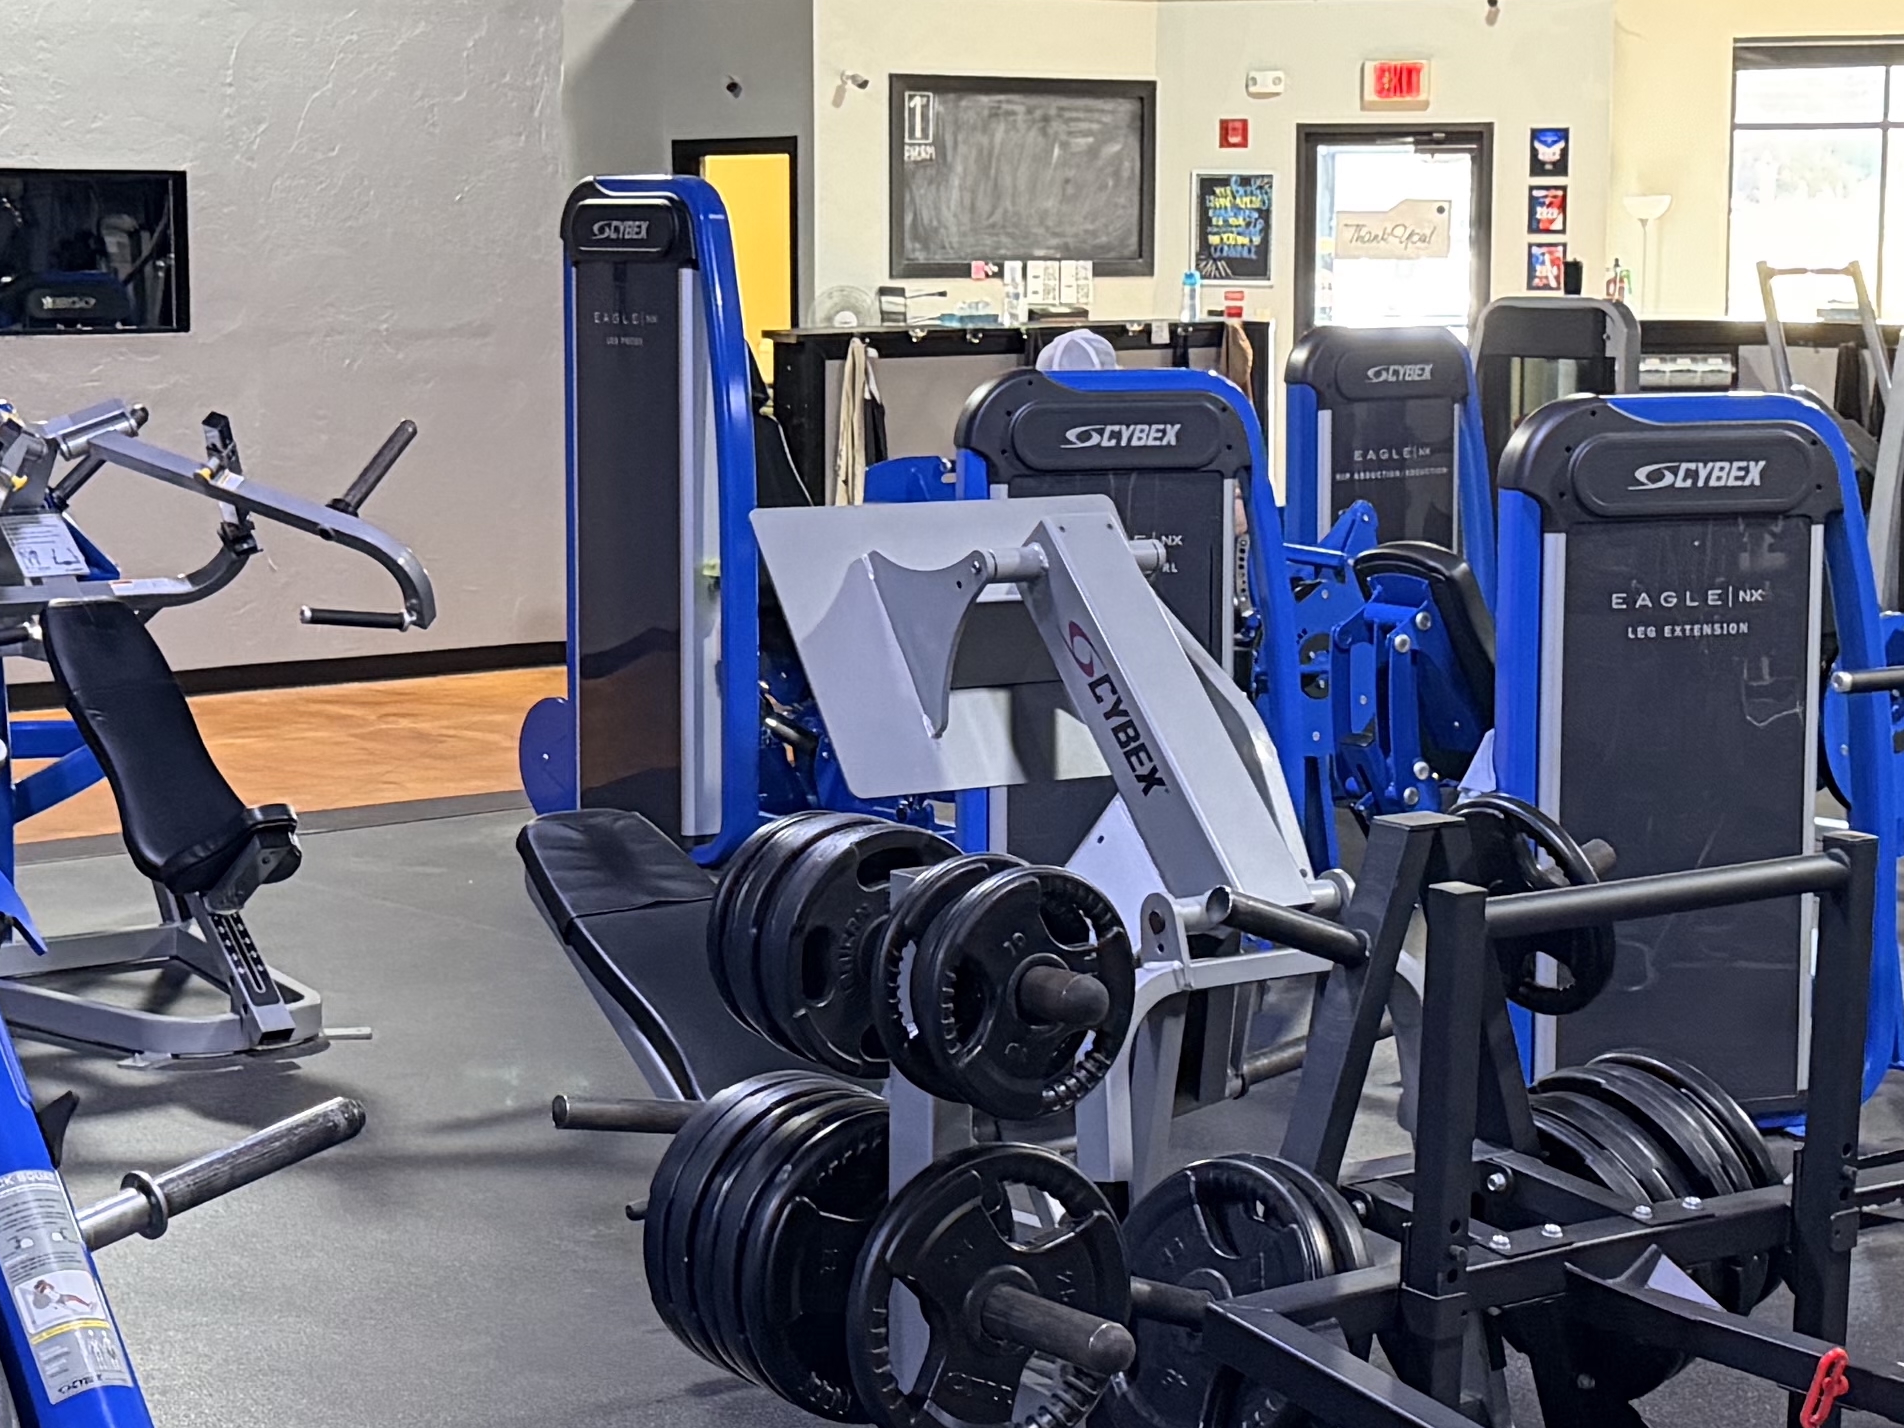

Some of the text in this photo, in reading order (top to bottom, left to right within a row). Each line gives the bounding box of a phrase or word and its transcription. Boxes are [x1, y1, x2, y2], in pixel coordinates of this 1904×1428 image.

[1373, 61, 1425, 99] EXIT
[609, 220, 650, 240] CYBEX
[593, 311, 640, 325] EAGLE
[1387, 363, 1434, 382] CYBEX
[1100, 423, 1182, 448] CYBEX
[1353, 446, 1412, 462] EAGLE
[1673, 460, 1767, 489] CYBEX
[1611, 587, 1764, 610] EAGLE NX
[1627, 621, 1749, 639] LEG EXTENSION
[1087, 673, 1167, 798] CYBEX
